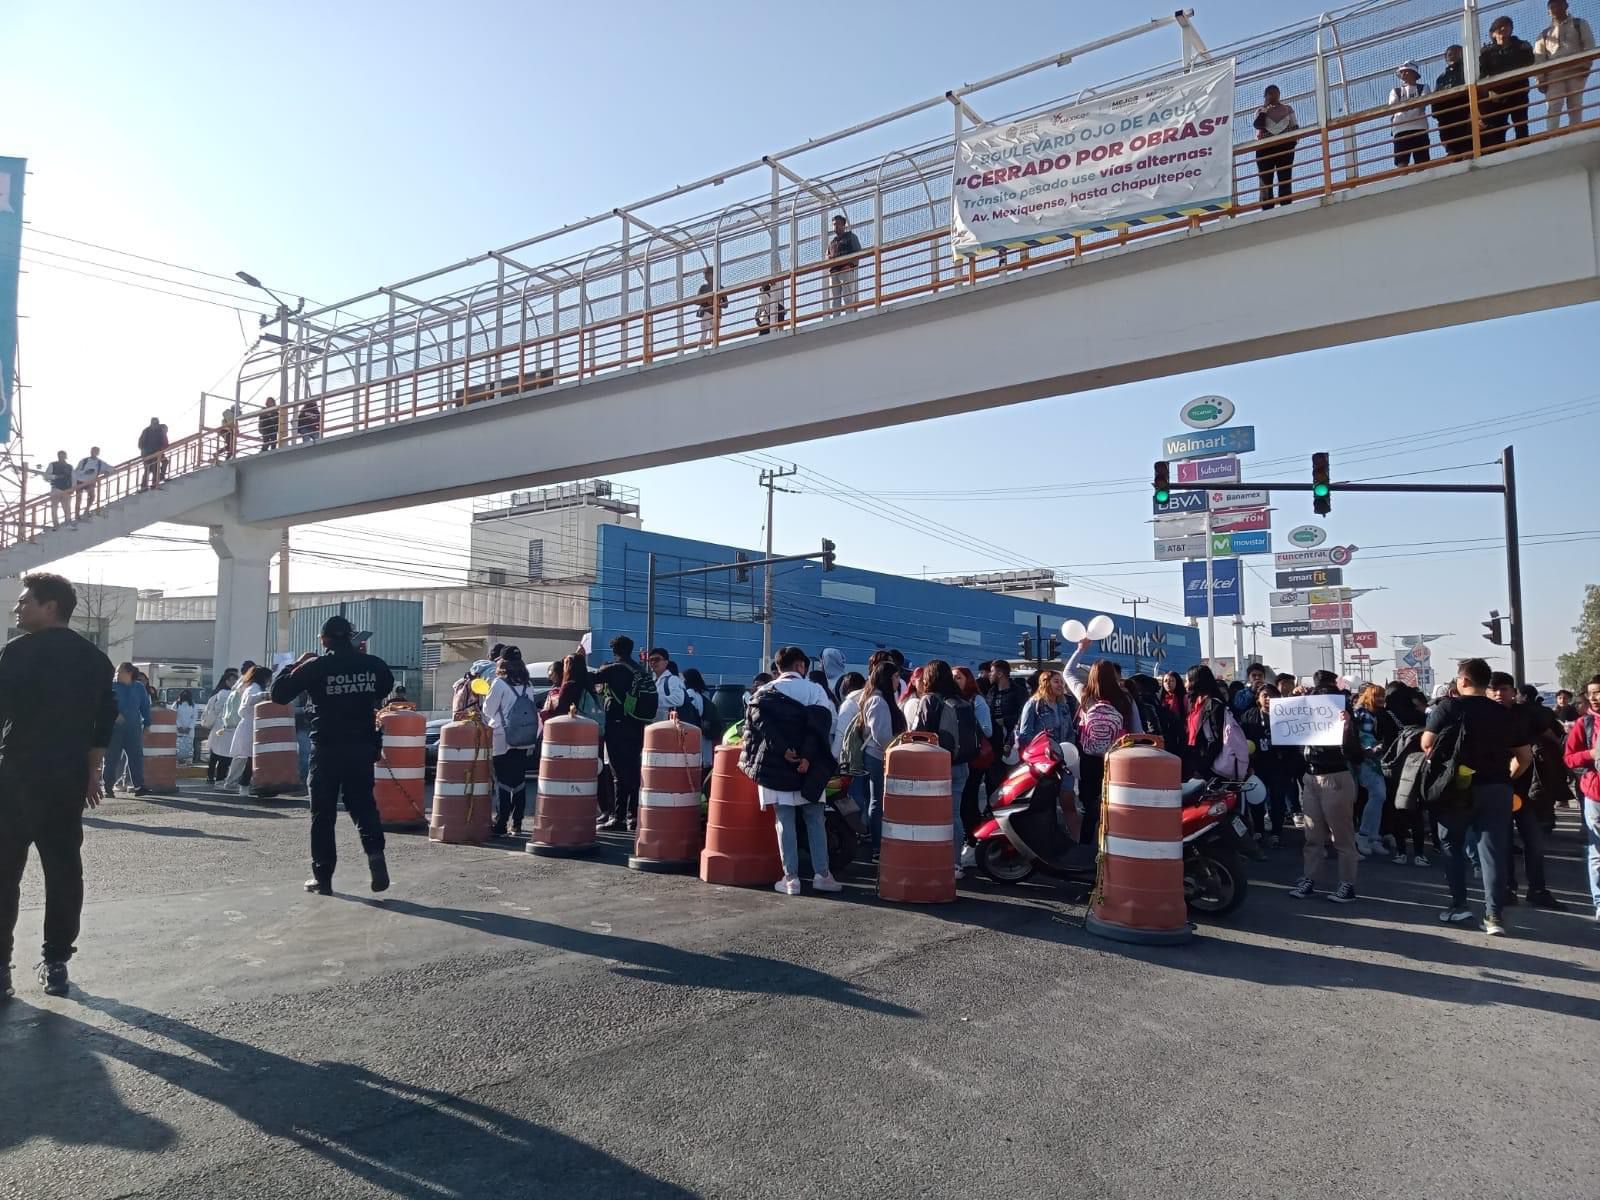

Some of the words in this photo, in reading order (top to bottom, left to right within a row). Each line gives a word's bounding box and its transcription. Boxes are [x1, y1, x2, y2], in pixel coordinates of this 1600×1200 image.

[1080, 122, 1116, 142] OJO
[1120, 115, 1143, 132] DE
[1147, 102, 1200, 125] AGUA
[1075, 141, 1124, 166] POR
[963, 191, 1017, 209] Tránsito
[1020, 179, 1069, 200] pesado
[1071, 172, 1096, 186] use
[1100, 161, 1133, 179] vías
[1136, 147, 1213, 170] alternas:
[971, 213, 990, 223] Av.
[992, 197, 1068, 219] Mexiquense,
[1070, 186, 1108, 203] hasta
[1111, 167, 1203, 193] Chapultepec
[1166, 434, 1226, 455] Walmart
[1200, 463, 1232, 477] Suburbia
[1226, 491, 1261, 501] Banamex
[1166, 544, 1186, 553] AT&T
[1233, 538, 1266, 547] movistar
[327, 671, 377, 685] POLICÍA
[326, 682, 376, 695] ESTATAL
[1274, 704, 1334, 719] QUEREMOS
